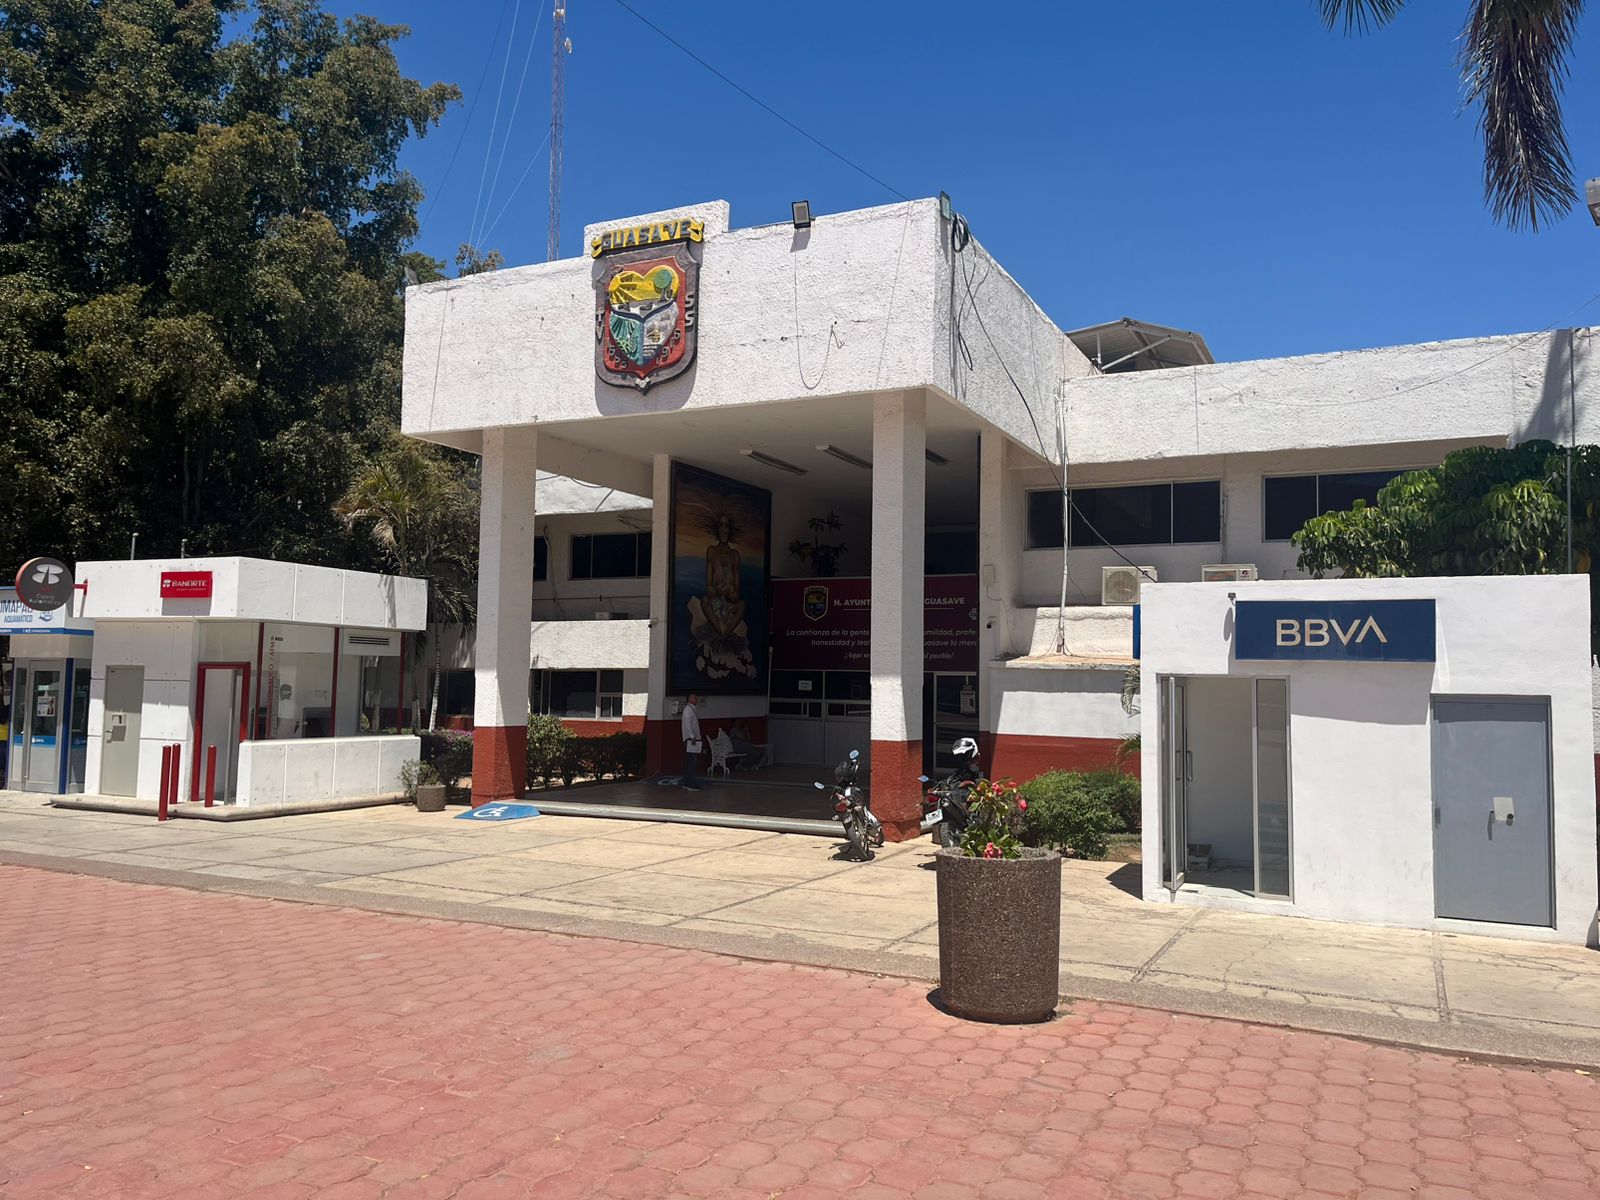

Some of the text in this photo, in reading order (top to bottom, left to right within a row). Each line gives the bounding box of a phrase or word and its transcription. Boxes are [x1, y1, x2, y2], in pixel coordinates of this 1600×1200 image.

[602, 221, 691, 249] GUASAVE
[924, 597, 966, 605] GUASAVE
[955, 628, 976, 637] profe
[1275, 615, 1388, 647] BBVA
